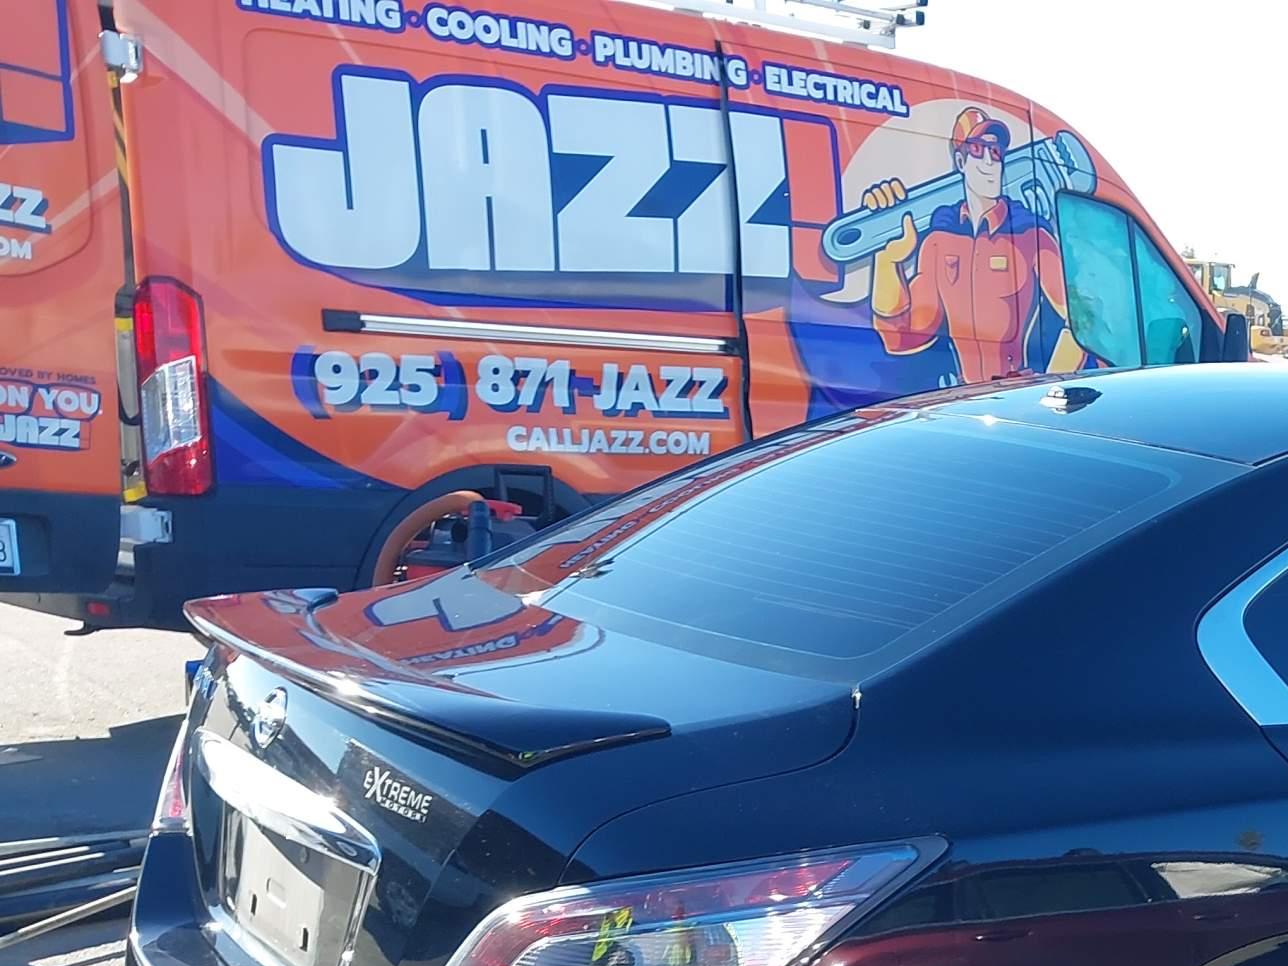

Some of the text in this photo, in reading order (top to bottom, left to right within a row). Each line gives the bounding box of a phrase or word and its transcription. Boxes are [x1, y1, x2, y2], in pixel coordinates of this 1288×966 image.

[240, 0, 907, 114] ATING COOLING PLUMBING ELECTRICAL
[272, 74, 790, 278] JAZZ
[38, 387, 99, 415] YOU
[291, 344, 468, 420] (925)
[0, 414, 81, 448] JAZZ
[507, 425, 709, 456] CALLJAZZ.COM
